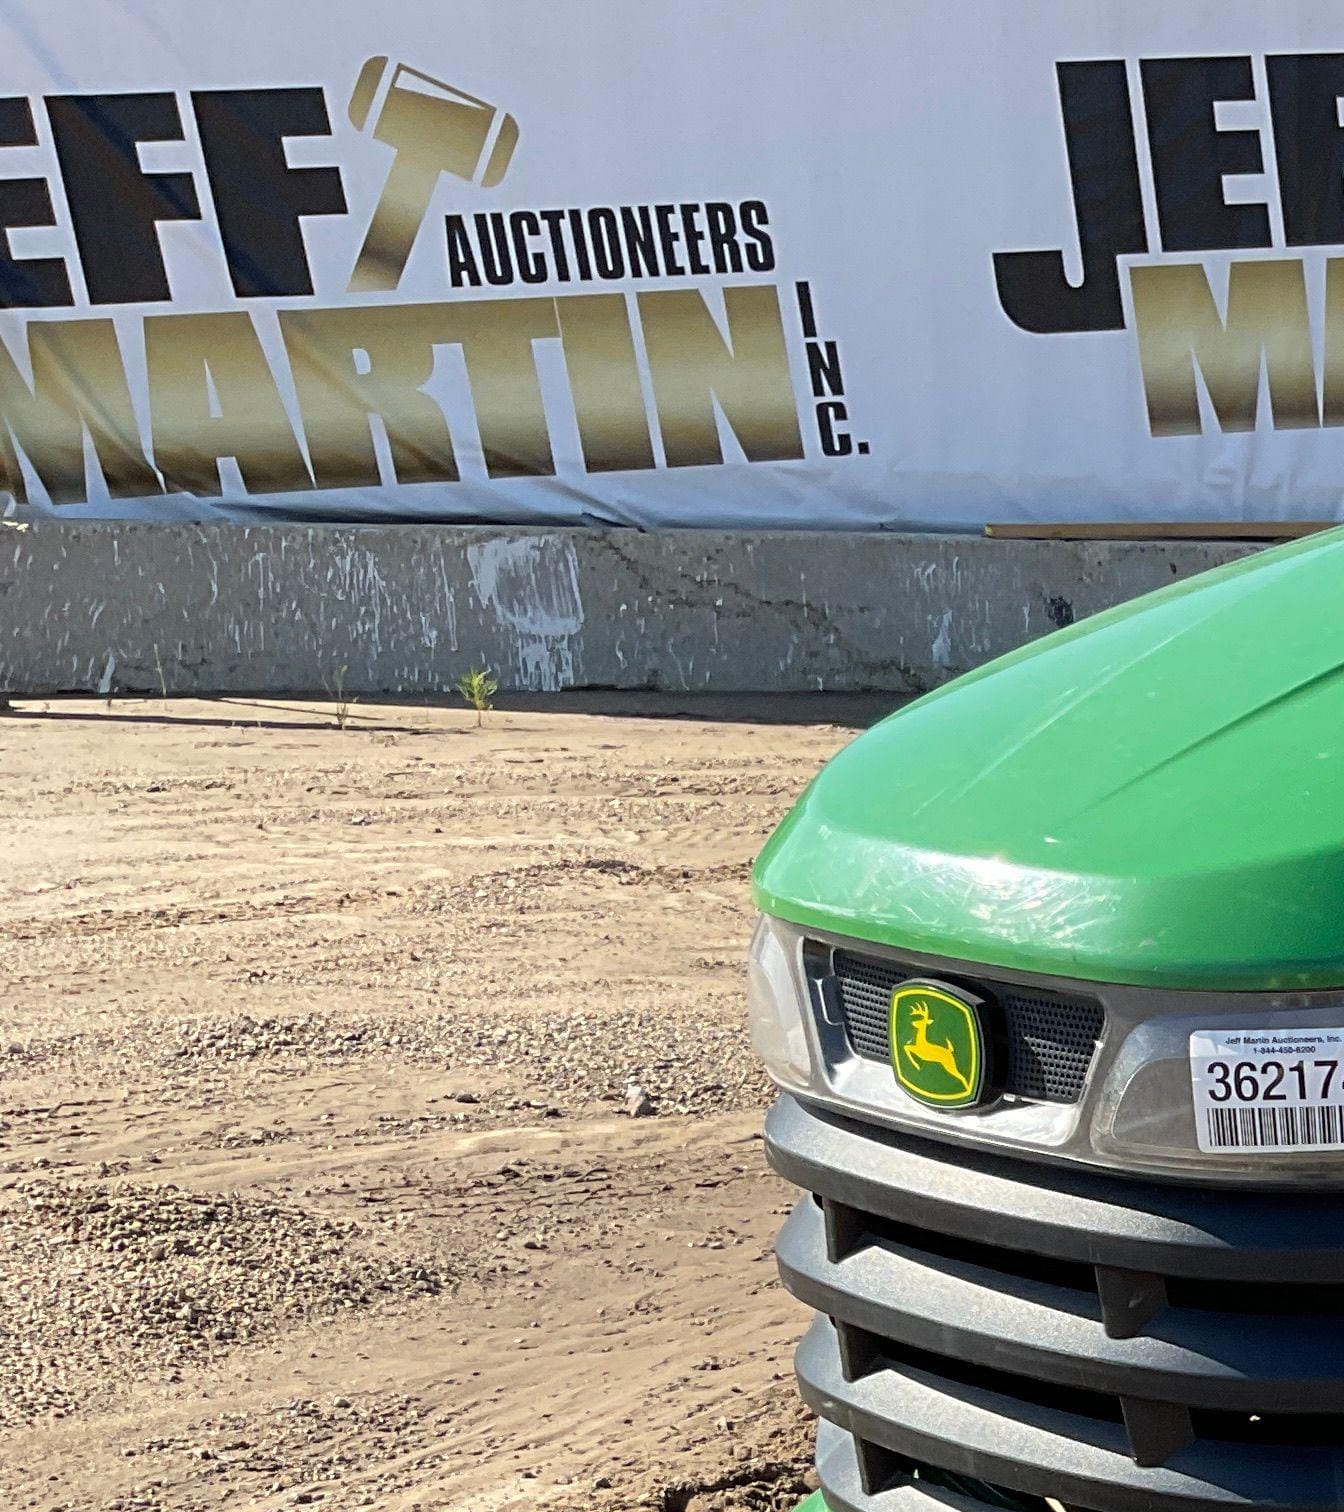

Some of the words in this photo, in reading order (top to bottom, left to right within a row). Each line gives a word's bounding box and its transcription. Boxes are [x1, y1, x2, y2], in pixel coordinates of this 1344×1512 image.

[444, 200, 776, 288] AUCTIONEERS
[0, 284, 805, 505] MARTIN
[1225, 1036, 1241, 1045] Jeff
[1243, 1036, 1270, 1045] Martin
[1326, 1035, 1342, 1043] Inc.
